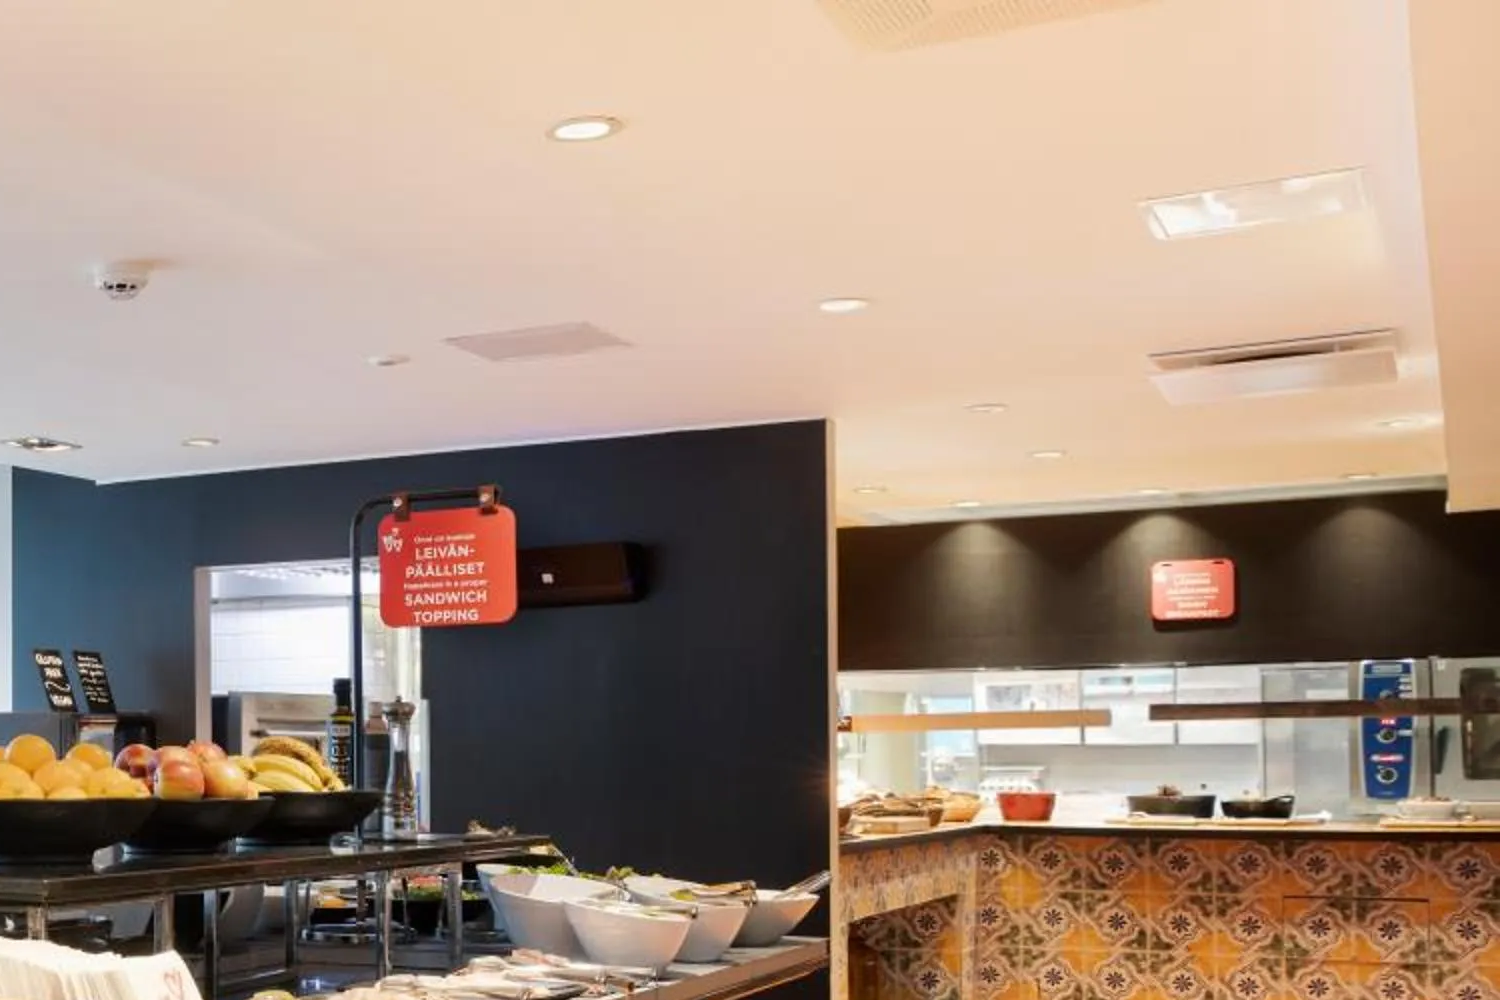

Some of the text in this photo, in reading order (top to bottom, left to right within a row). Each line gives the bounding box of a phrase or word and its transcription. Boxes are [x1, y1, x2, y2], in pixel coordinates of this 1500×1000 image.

[405, 562, 485, 578] PÄÄLLISET
[404, 590, 488, 606] SANDWICH
[414, 609, 479, 623] TOPPING
